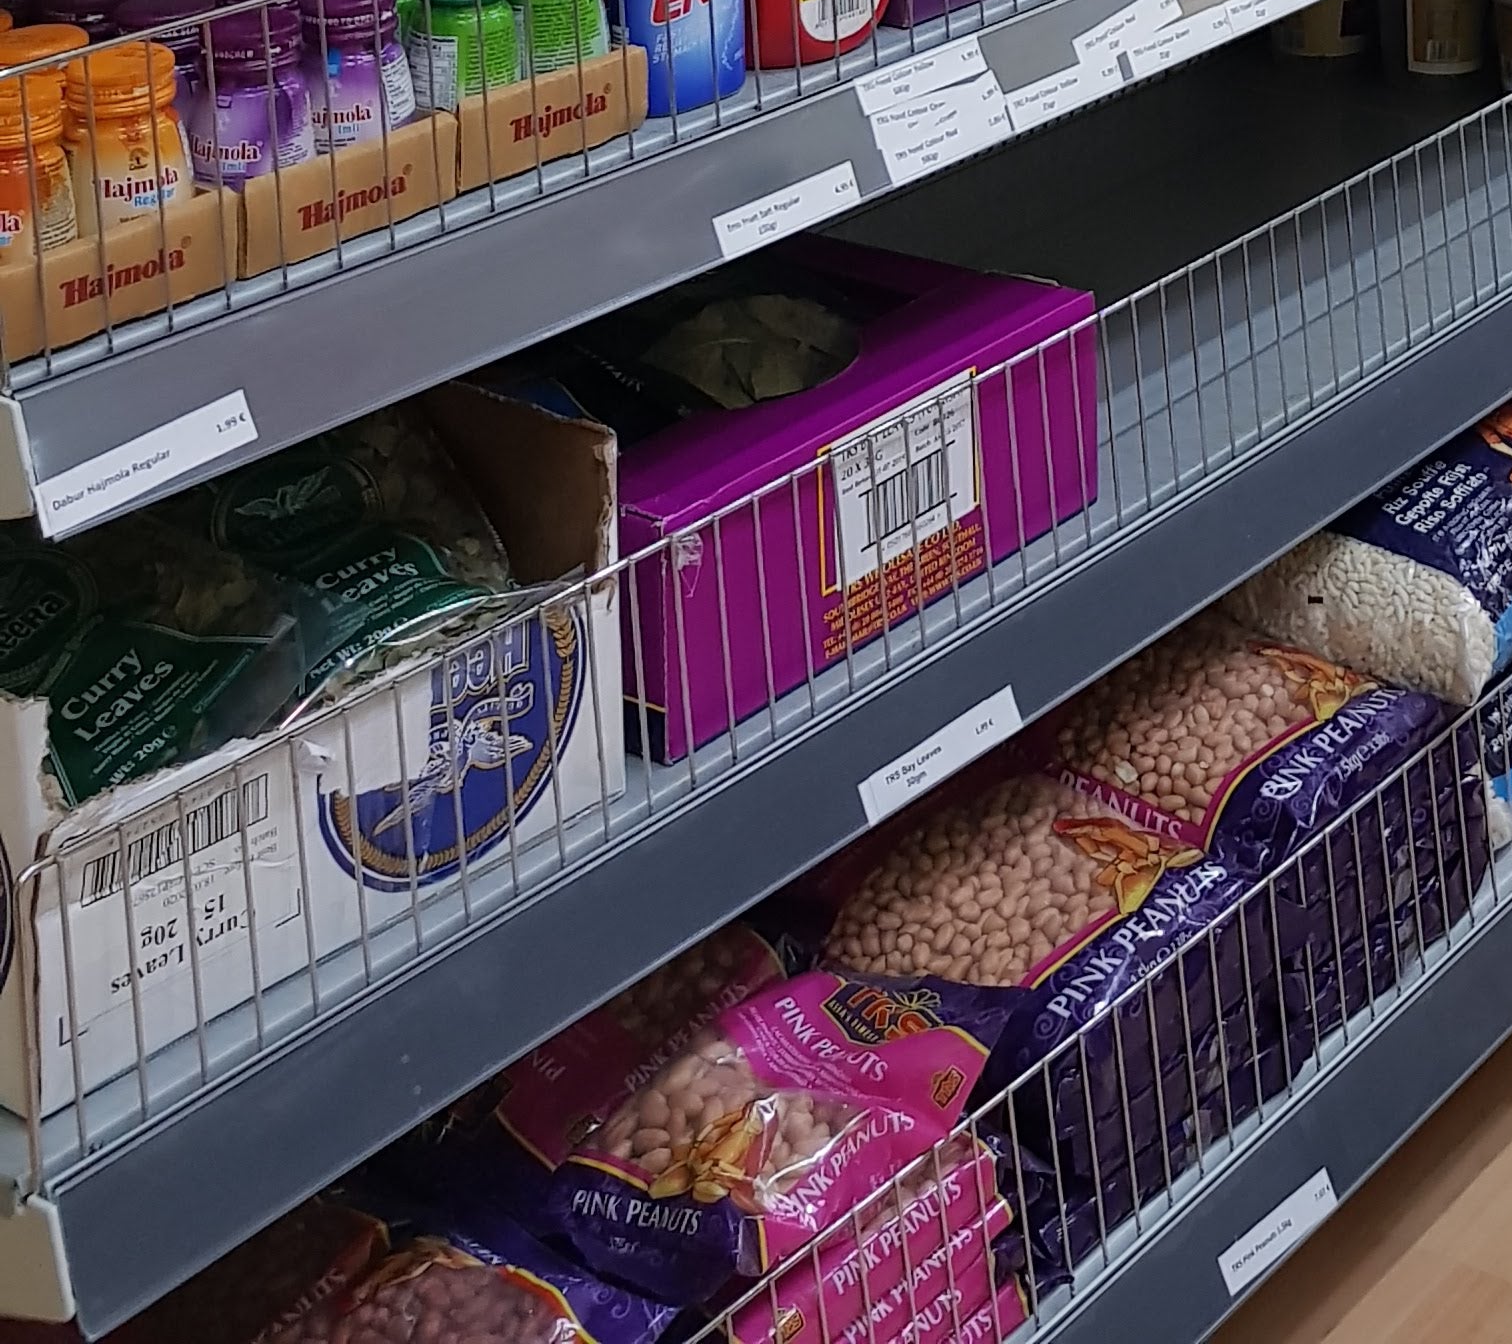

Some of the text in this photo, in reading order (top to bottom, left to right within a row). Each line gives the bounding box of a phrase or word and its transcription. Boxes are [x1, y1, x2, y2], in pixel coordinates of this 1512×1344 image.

[298, 171, 407, 232] Hajmola
[60, 241, 185, 311] Hajmola
[52, 489, 86, 511] Dabur
[87, 468, 131, 496] Hajmola
[131, 448, 171, 472] Regular
[1382, 495, 1409, 515] Riz
[1413, 510, 1446, 534] Riso
[314, 545, 399, 591] Curry
[320, 560, 420, 613] Leaves
[59, 647, 145, 722] Curry
[73, 659, 175, 743] Leaves
[901, 762, 917, 776] Bay
[916, 746, 943, 766] Leaves
[140, 917, 179, 949] 20g
[1046, 859, 1228, 1020] PINK PEANUTS
[774, 996, 820, 1044] PINK
[830, 1109, 916, 1178] PEANUTS
[571, 1189, 703, 1235] PINK PEANUTS
[831, 1176, 962, 1296] PINK PEANUTS
